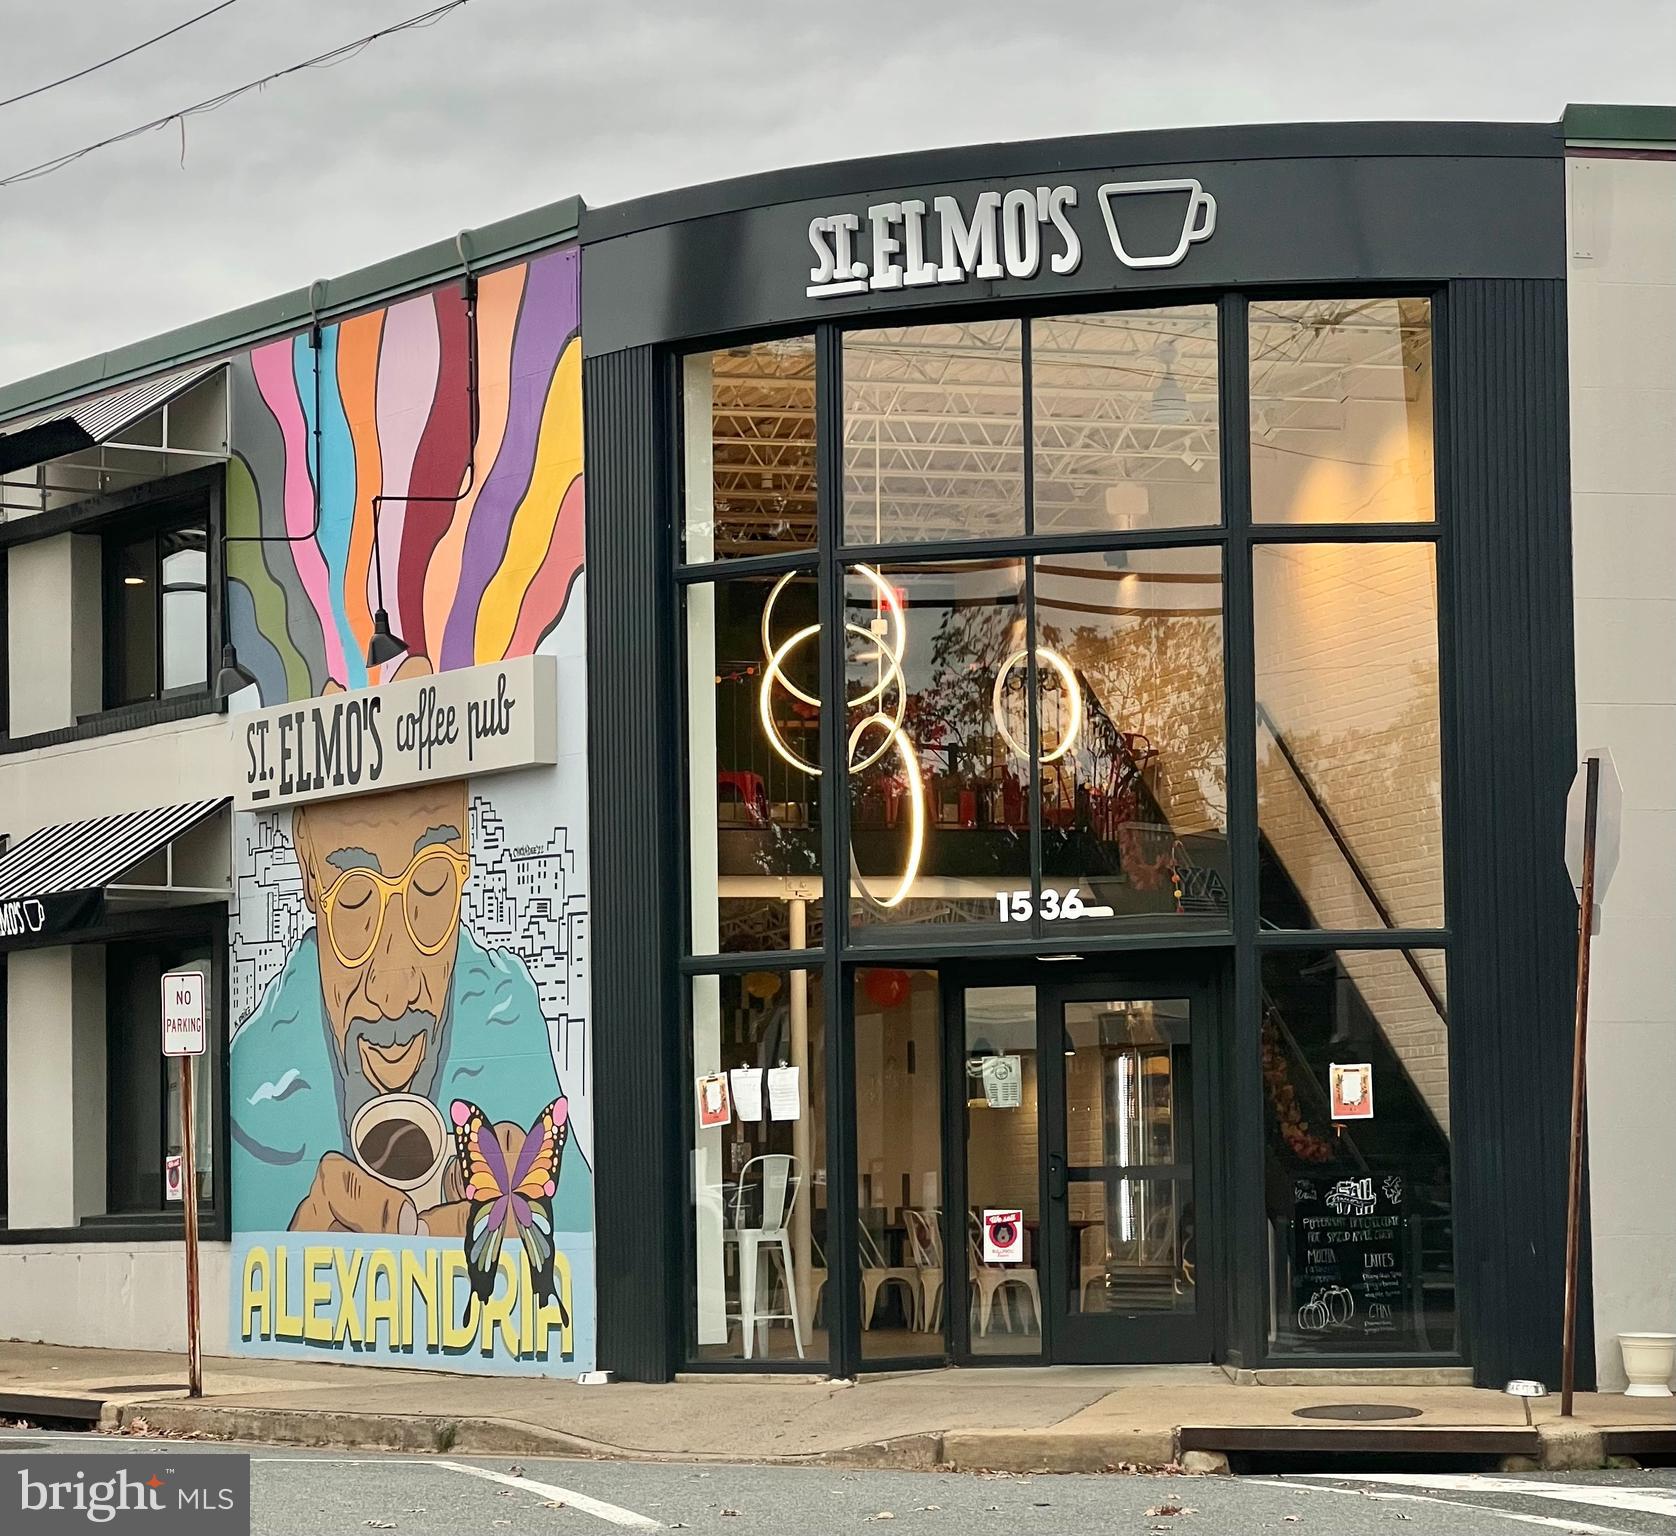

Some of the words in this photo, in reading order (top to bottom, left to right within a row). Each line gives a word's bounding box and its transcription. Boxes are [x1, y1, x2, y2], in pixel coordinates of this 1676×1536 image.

[868, 185, 1081, 289] ELMO'S
[247, 719, 274, 784] ST.
[278, 696, 383, 796] ELMO'S
[396, 685, 459, 771] coffee
[467, 672, 516, 762] pub
[166, 1017, 202, 1033] PARKING
[176, 990, 191, 1006] NO
[241, 1245, 575, 1363] ALEXANDRIA
